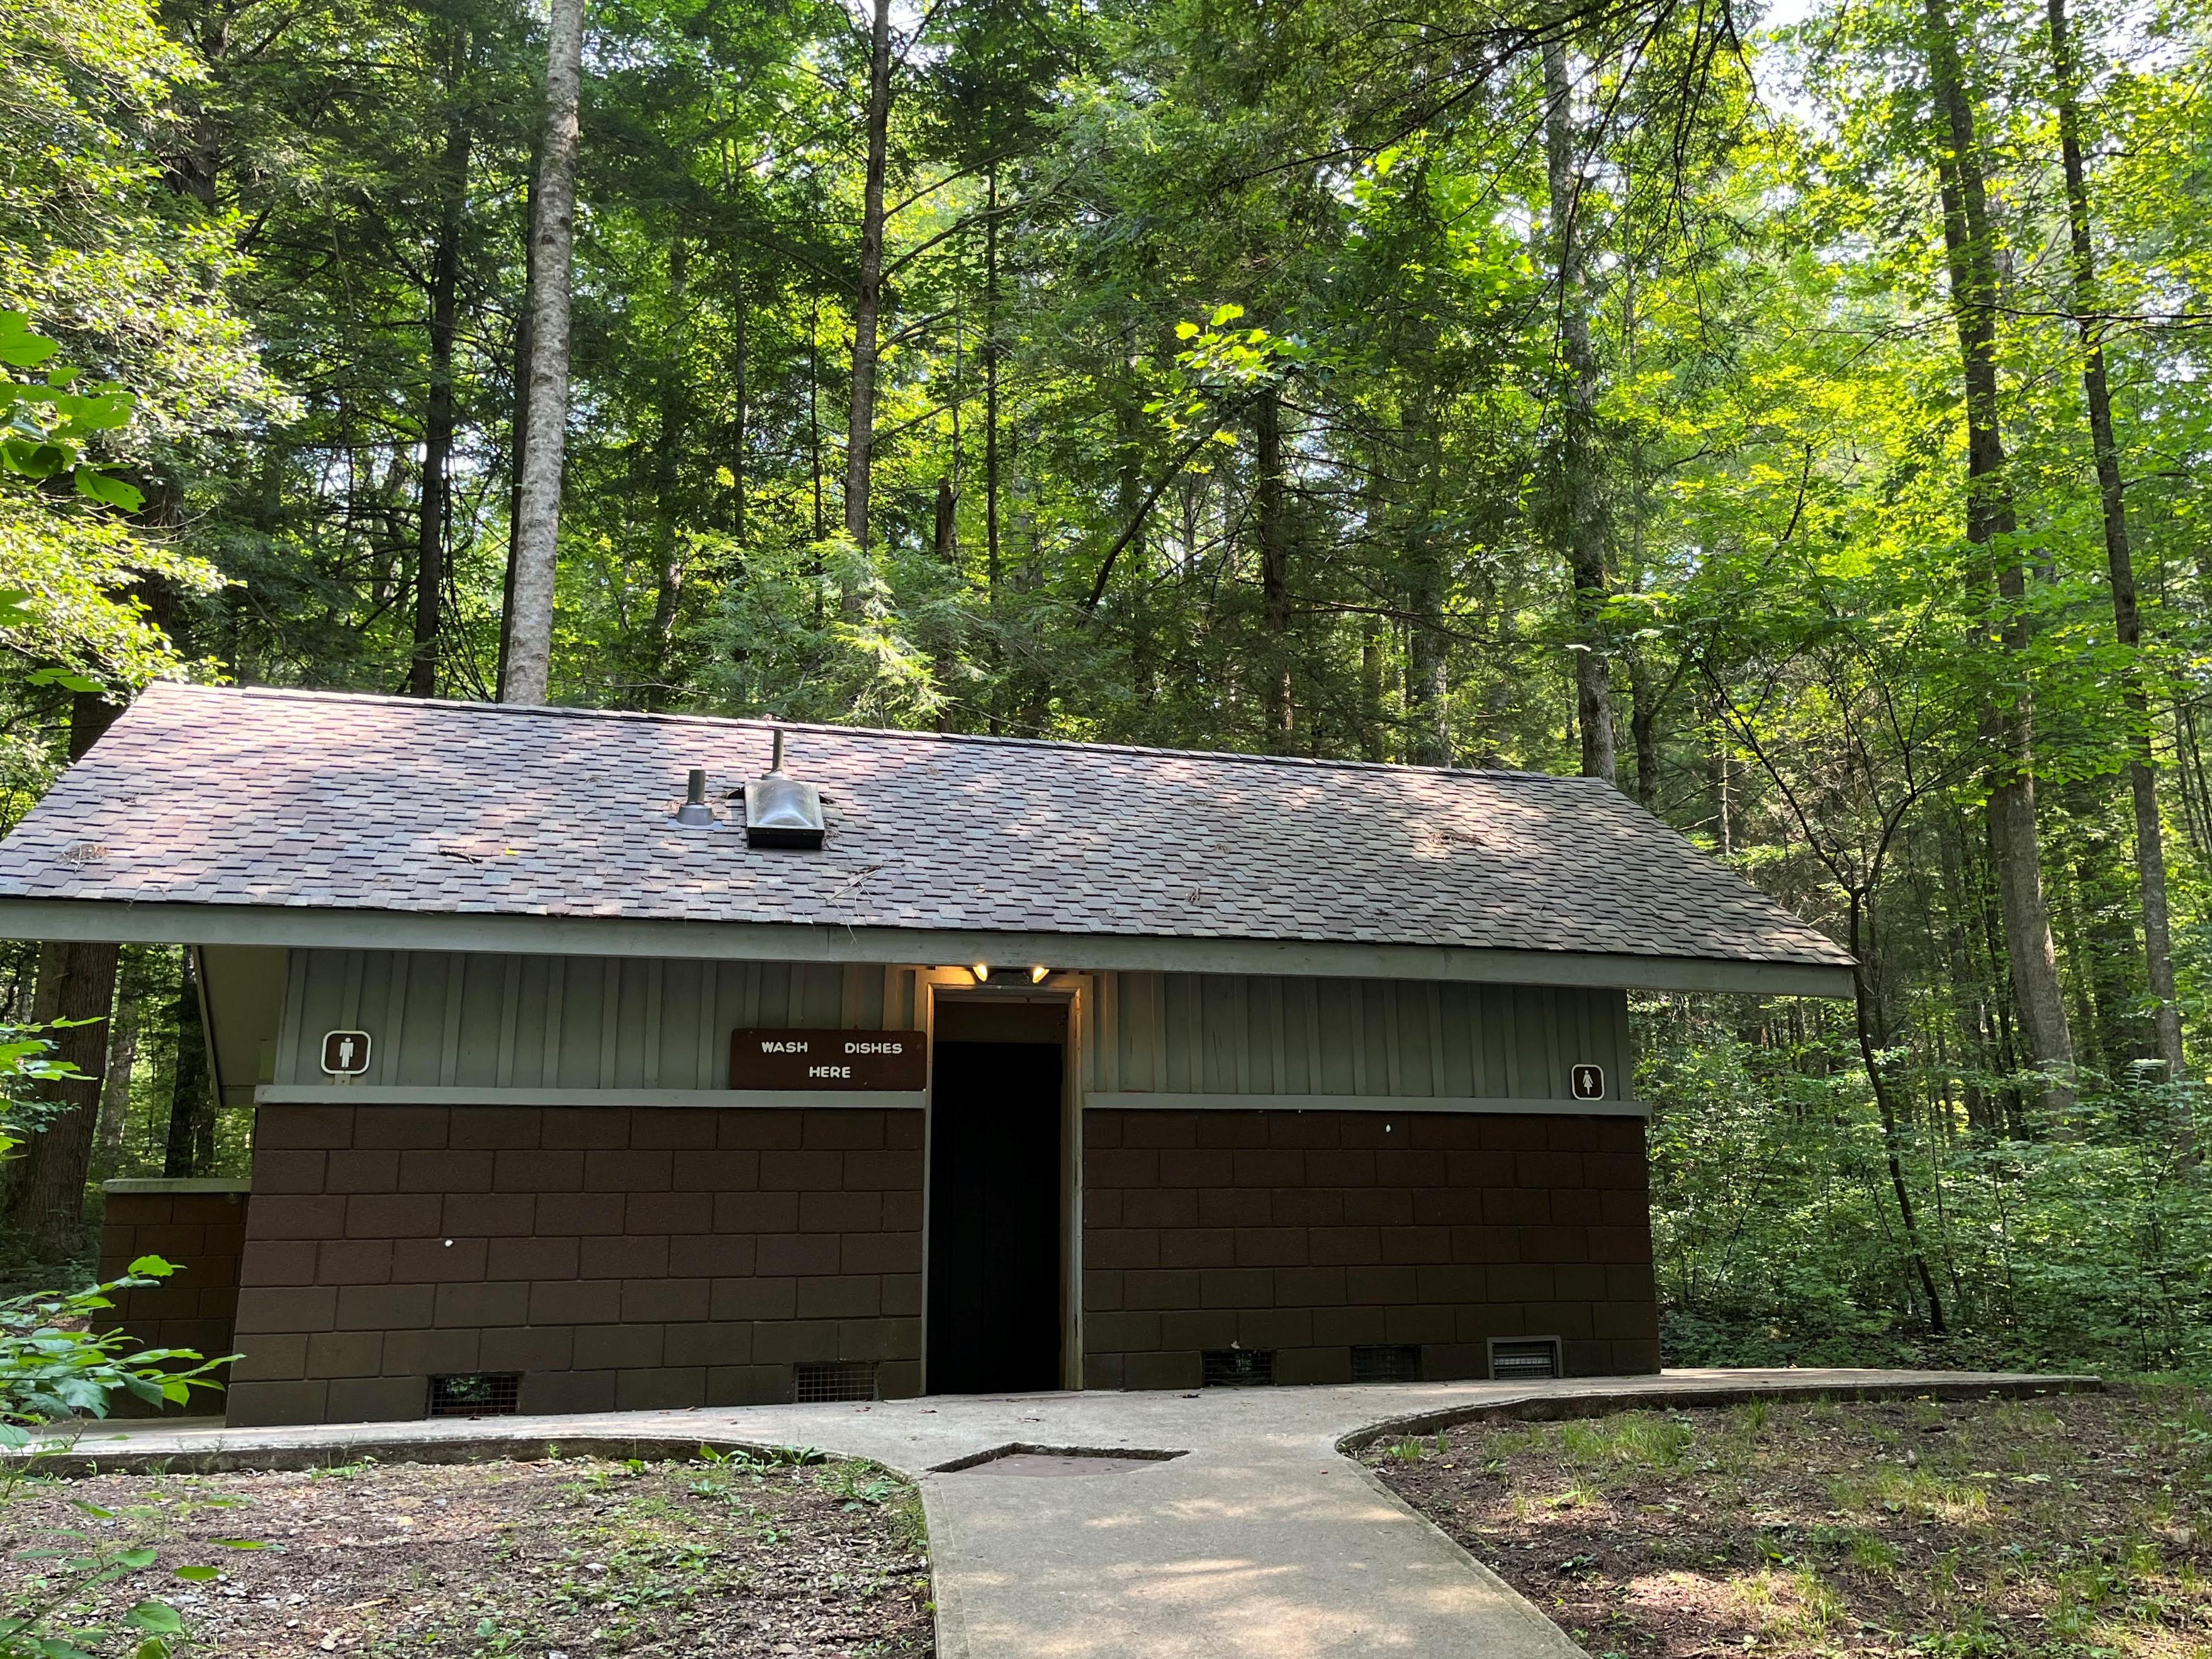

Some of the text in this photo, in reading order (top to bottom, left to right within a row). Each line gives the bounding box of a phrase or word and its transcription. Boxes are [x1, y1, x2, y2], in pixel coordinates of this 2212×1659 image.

[761, 1042, 902, 1054] WASH DISHES
[809, 1066, 851, 1078] HERE
